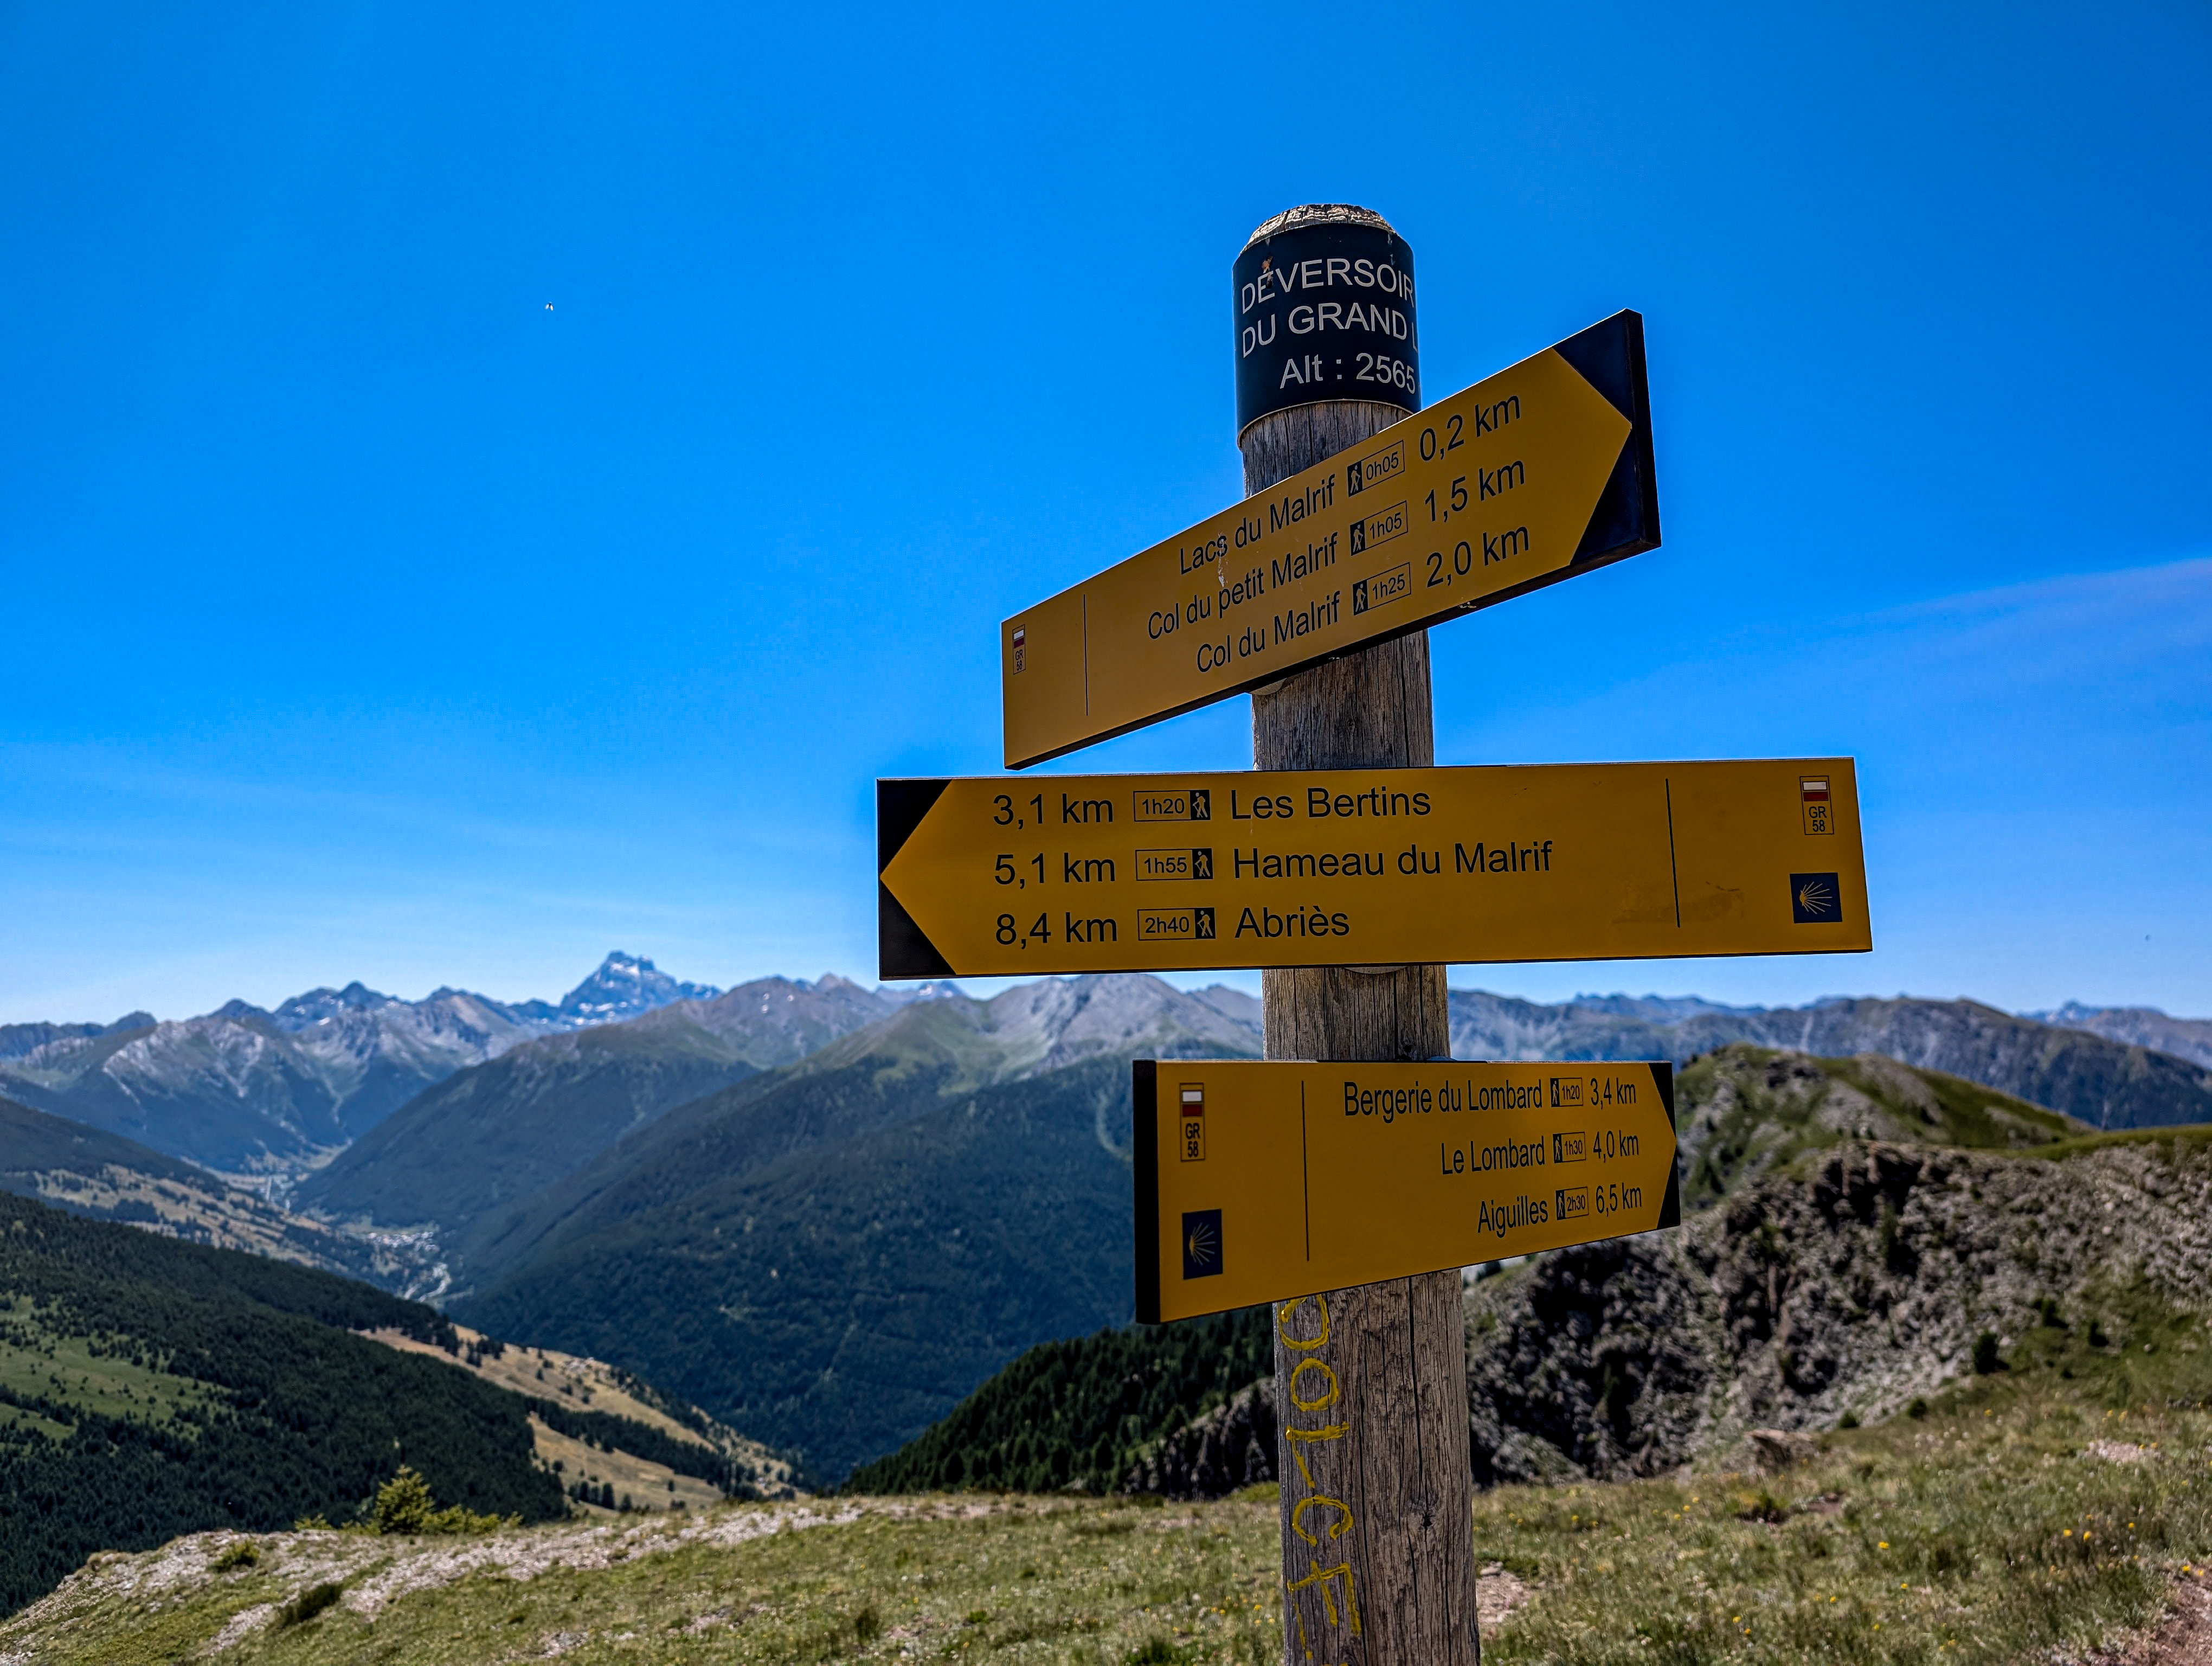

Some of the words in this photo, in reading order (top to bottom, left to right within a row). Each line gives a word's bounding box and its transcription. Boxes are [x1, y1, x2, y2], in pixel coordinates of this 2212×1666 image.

[1242, 313, 1276, 359] DU
[1288, 302, 1407, 341] GRAND
[1279, 354, 1324, 389] Alt
[1355, 352, 1416, 394] 2565
[1180, 535, 1229, 575] Lacs
[1234, 516, 1262, 549] du
[1269, 473, 1336, 534] Malrif
[1366, 450, 1399, 481] 0h05
[1419, 414, 1465, 462] 0,2
[1474, 395, 1521, 438] km
[1148, 602, 1180, 640] Col
[1186, 594, 1211, 624] du
[1218, 567, 1265, 619] petit
[1271, 531, 1339, 589] Malrif
[1369, 511, 1403, 540] 1h05
[1424, 475, 1468, 523] 1,5
[1478, 460, 1525, 502] km
[1197, 634, 1231, 673] Col
[1238, 626, 1266, 658] du
[1274, 590, 1341, 646] Malrif
[1372, 573, 1406, 600] 1h25
[1426, 541, 1472, 588] 2,0
[1482, 526, 1529, 567] km
[1014, 648, 1024, 661] GR
[1015, 659, 1023, 672] 58
[993, 793, 1043, 830] 3,1
[1062, 792, 1114, 824] km
[1141, 797, 1185, 815] 1h20
[1231, 789, 1294, 820] Les
[1307, 785, 1431, 818] Bertins
[1808, 805, 1828, 819] GR
[1811, 819, 1826, 833] 58
[994, 852, 1045, 890] 5,1
[1063, 851, 1116, 883] km
[1143, 856, 1188, 874] 1h55
[1233, 847, 1385, 879] Hameau
[1397, 843, 1441, 875] du
[1454, 840, 1553, 874] Malrif
[995, 912, 1052, 950] 8,4
[1065, 911, 1117, 943] km
[1144, 915, 1190, 934] 2h40
[1234, 905, 1350, 939] Abriès
[1343, 1080, 1432, 1124] Bergerie
[1438, 1079, 1462, 1113] du
[1467, 1078, 1543, 1111] Lombard
[1561, 1084, 1580, 1100] 1h20
[1590, 1077, 1613, 1110] 3,4
[1616, 1077, 1637, 1105] km
[1185, 1122, 1201, 1140] GR
[1187, 1140, 1199, 1158] 58
[1441, 1142, 1465, 1176] Le
[1470, 1135, 1546, 1172] Lombard
[1564, 1139, 1583, 1156] 1h30
[1592, 1130, 1615, 1163] 4,0
[1618, 1129, 1639, 1157] km
[1477, 1194, 1549, 1239] Aiguilles
[1566, 1194, 1586, 1212] 2h30
[1595, 1183, 1618, 1218] 6,5
[1621, 1182, 1642, 1210] km
